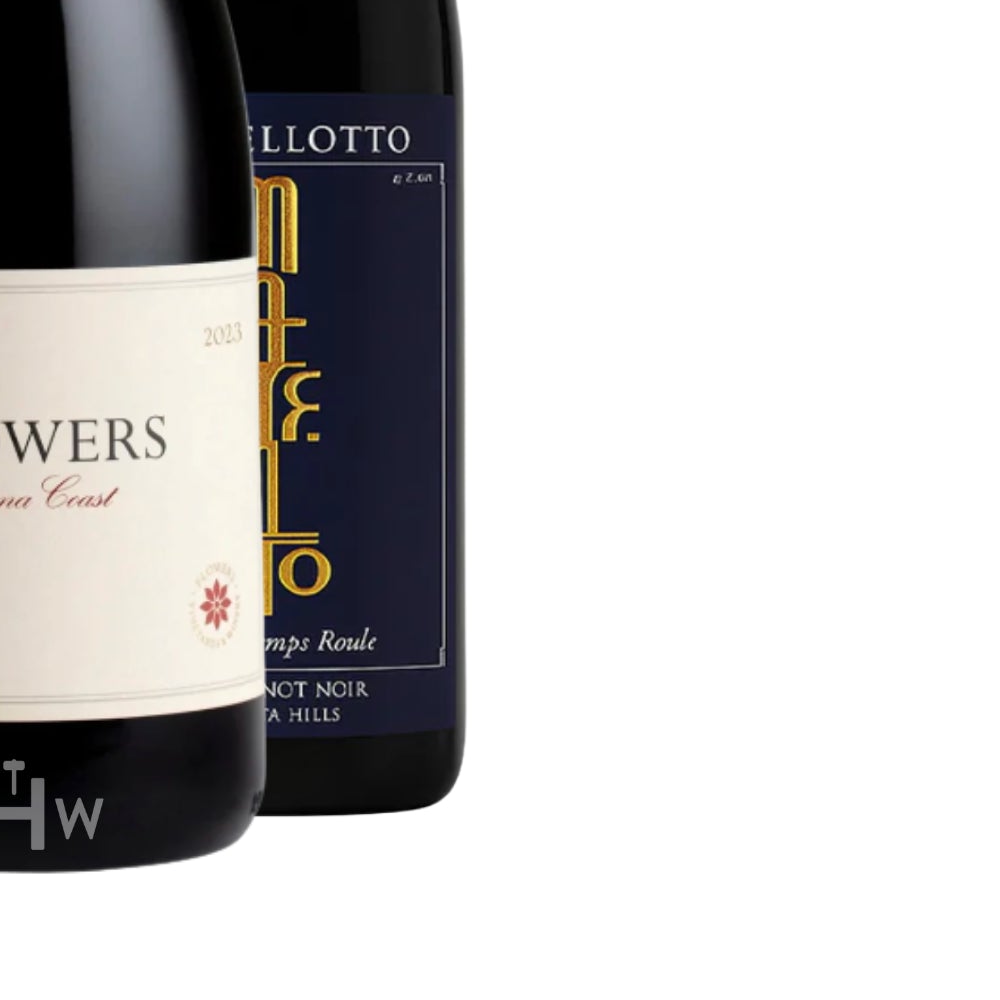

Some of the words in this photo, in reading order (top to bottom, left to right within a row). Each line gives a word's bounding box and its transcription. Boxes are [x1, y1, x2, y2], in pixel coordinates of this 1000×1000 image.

[203, 321, 243, 347] 2023
[41, 474, 120, 510] Coast
[317, 627, 377, 652] Roule
[316, 680, 369, 698] NOIR
[289, 707, 342, 722] HILLS
